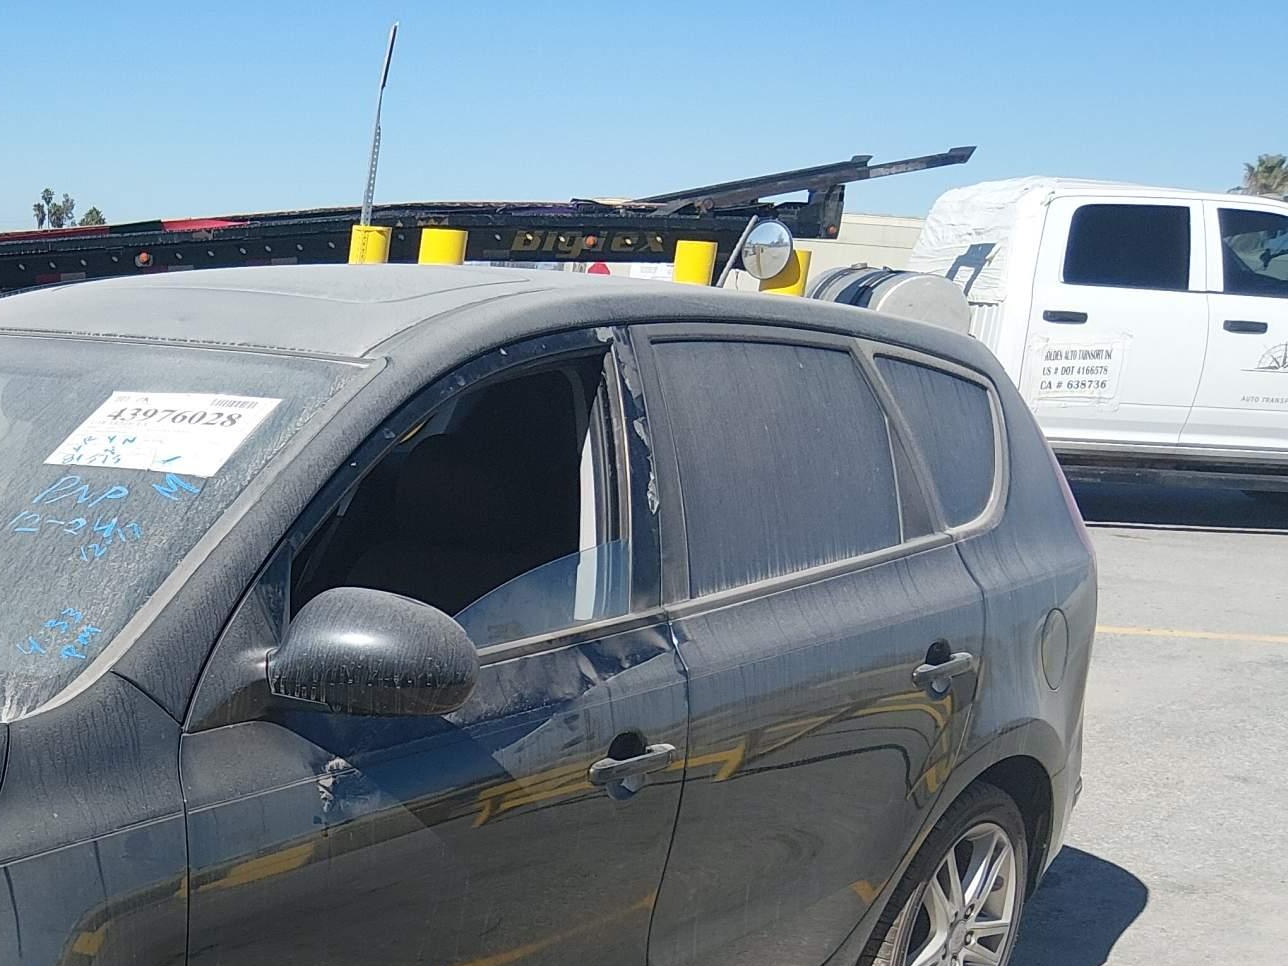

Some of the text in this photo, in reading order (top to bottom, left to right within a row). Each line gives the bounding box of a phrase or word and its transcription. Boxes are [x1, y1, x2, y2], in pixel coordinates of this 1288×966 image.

[1042, 366, 1051, 376] US
[1061, 365, 1075, 376] DOT
[1040, 380, 1052, 390] CA
[1066, 379, 1107, 389] 638736
[1240, 395, 1260, 403] AUTO
[105, 406, 243, 428] 43976028
